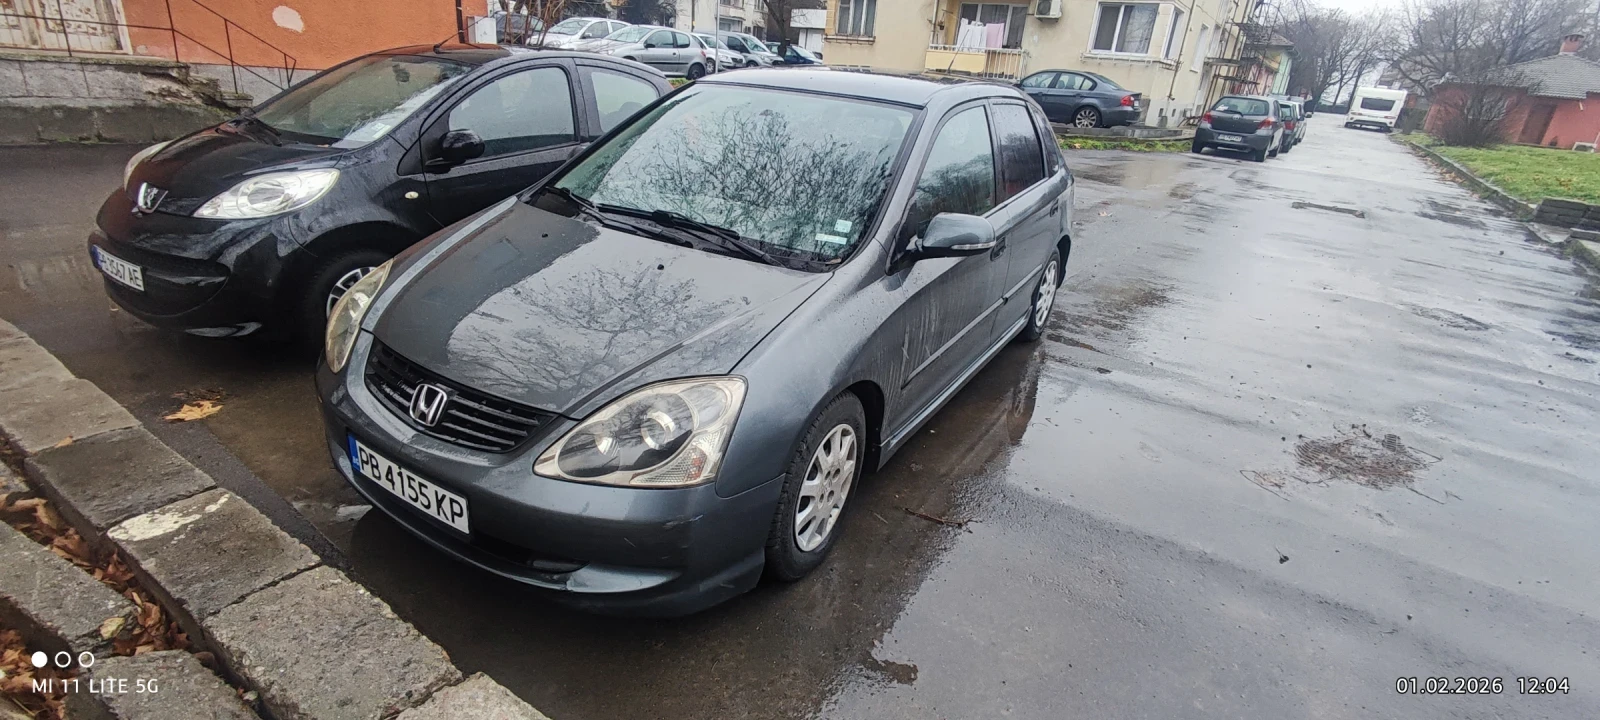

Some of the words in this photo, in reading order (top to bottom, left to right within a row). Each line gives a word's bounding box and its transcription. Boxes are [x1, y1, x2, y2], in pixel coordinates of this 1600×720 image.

[128, 267, 141, 287] AE
[359, 446, 381, 481] PB
[385, 465, 431, 510] 4155
[435, 490, 463, 524] KP
